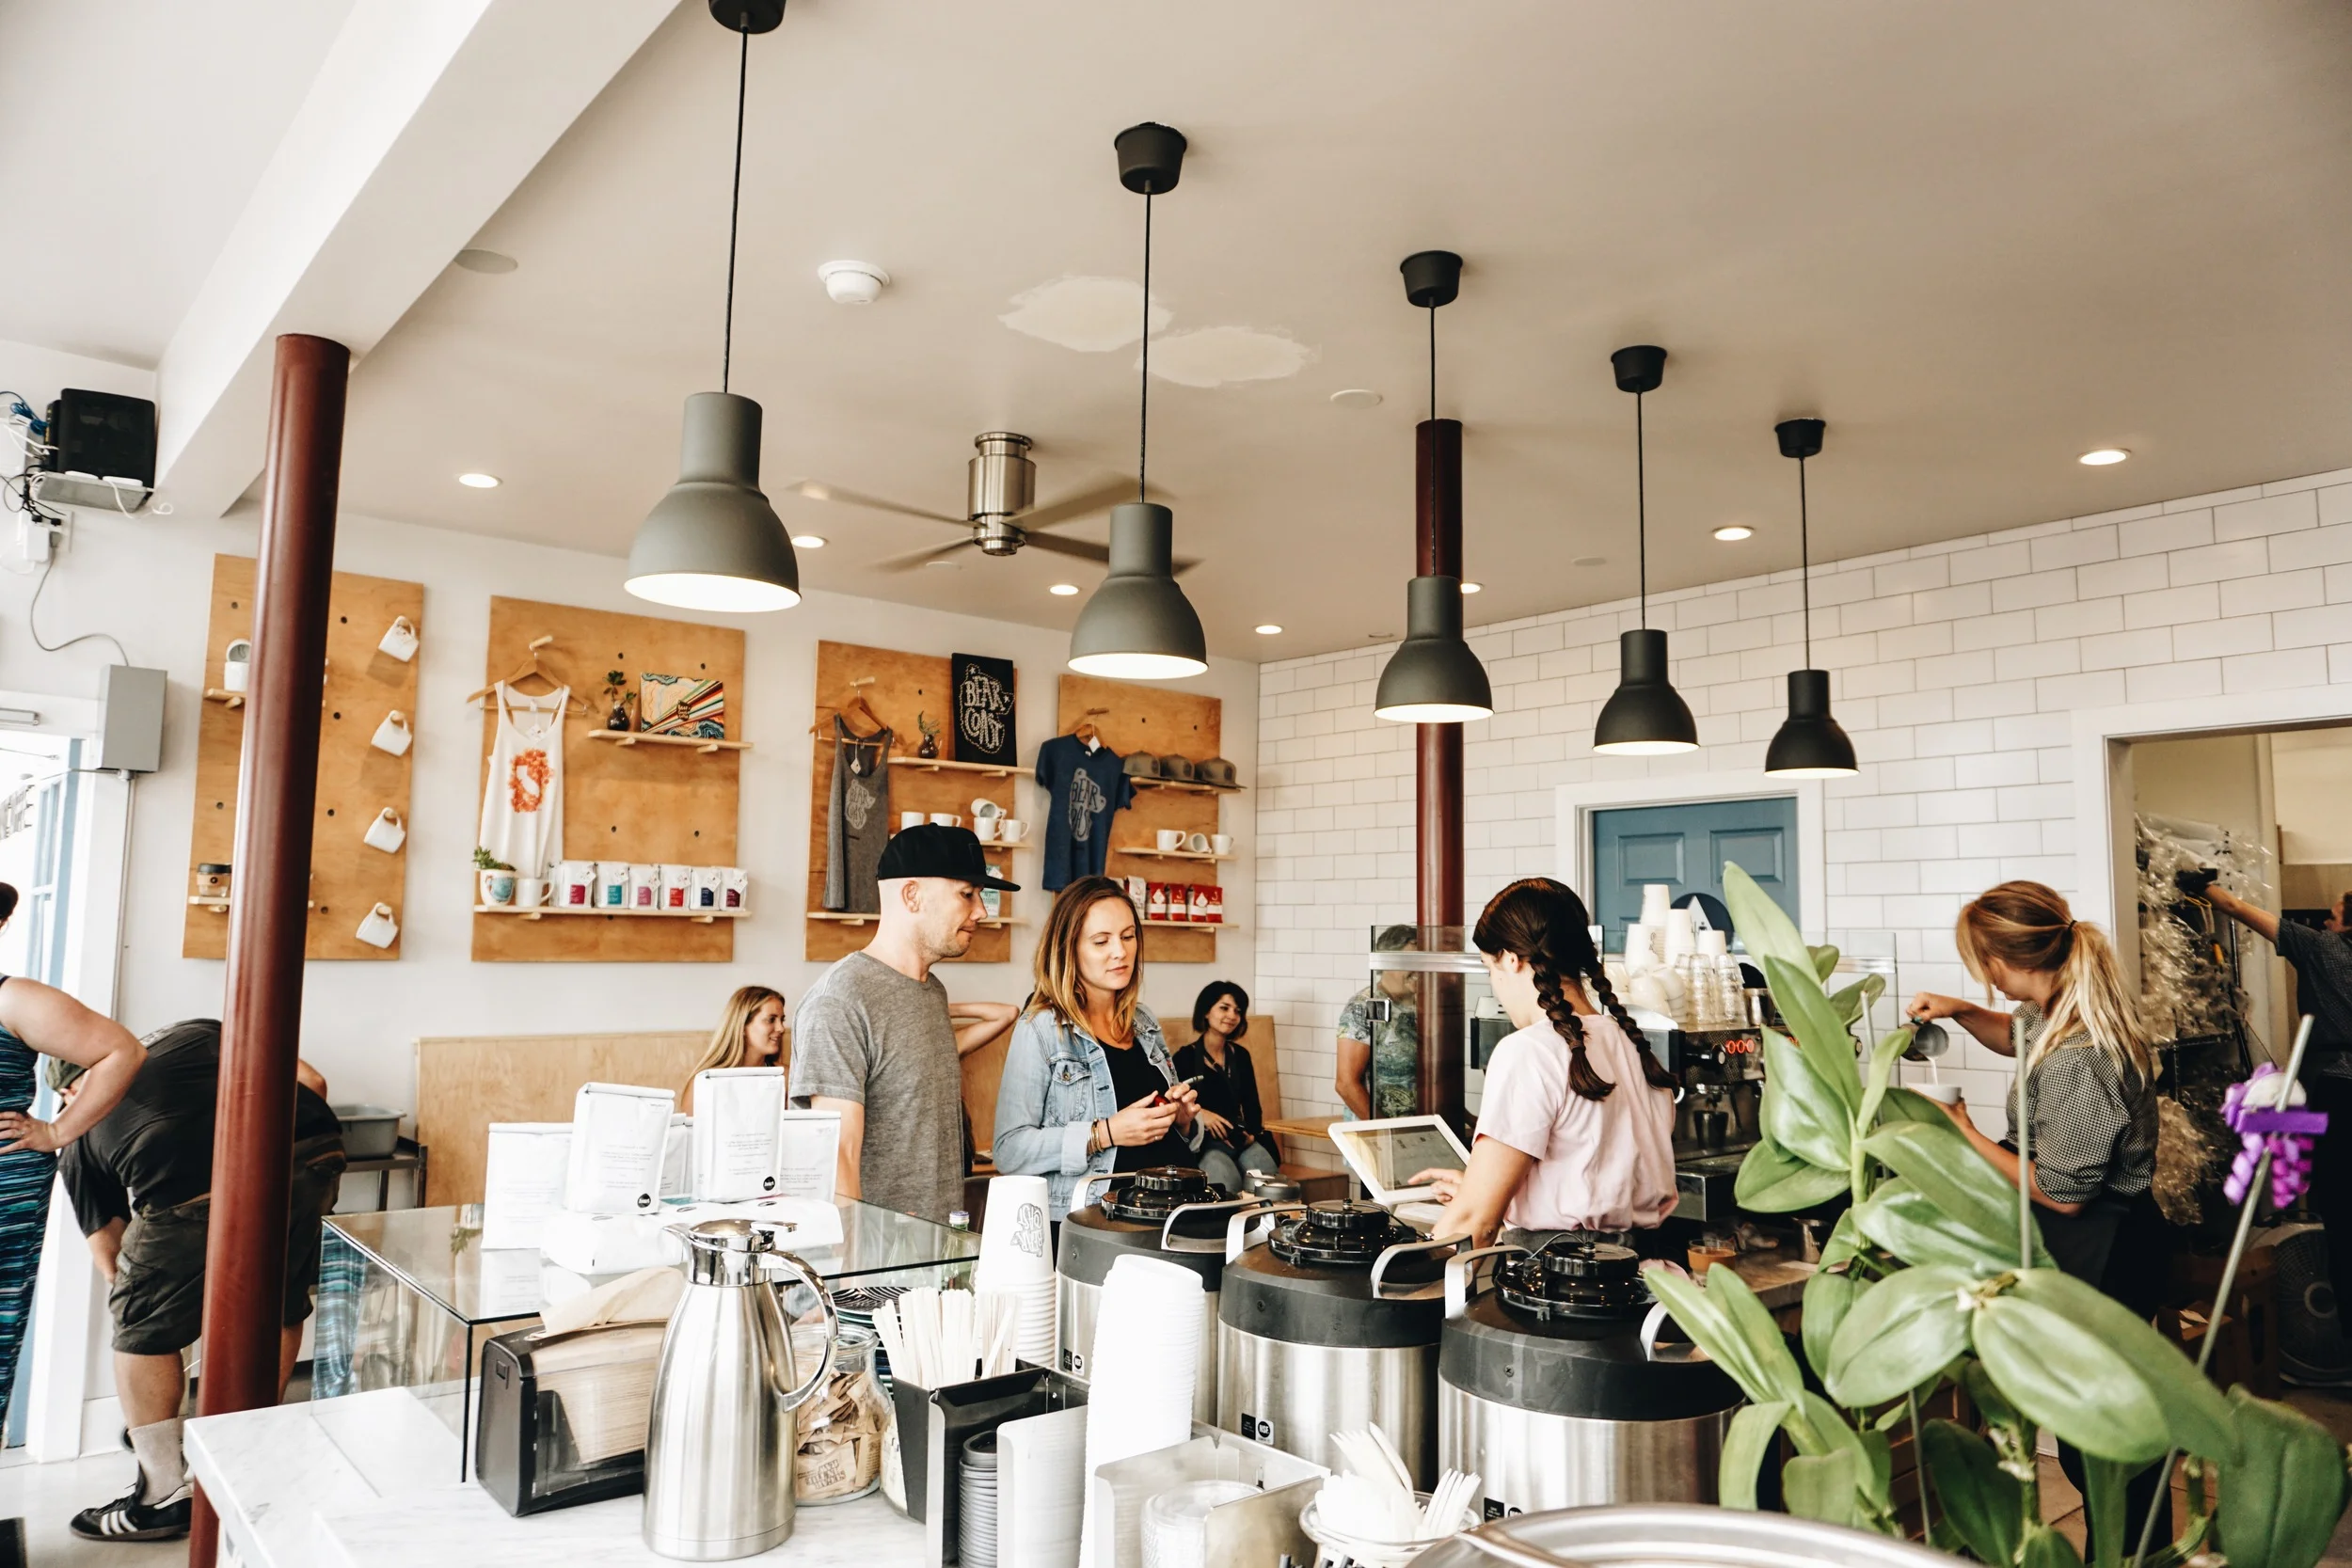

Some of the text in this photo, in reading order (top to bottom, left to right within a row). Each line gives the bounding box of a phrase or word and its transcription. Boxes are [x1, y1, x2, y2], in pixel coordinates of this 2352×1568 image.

[963, 675, 1006, 711] BEAR
[964, 707, 1005, 749] COAST
[1071, 778, 1099, 811] BEAR
